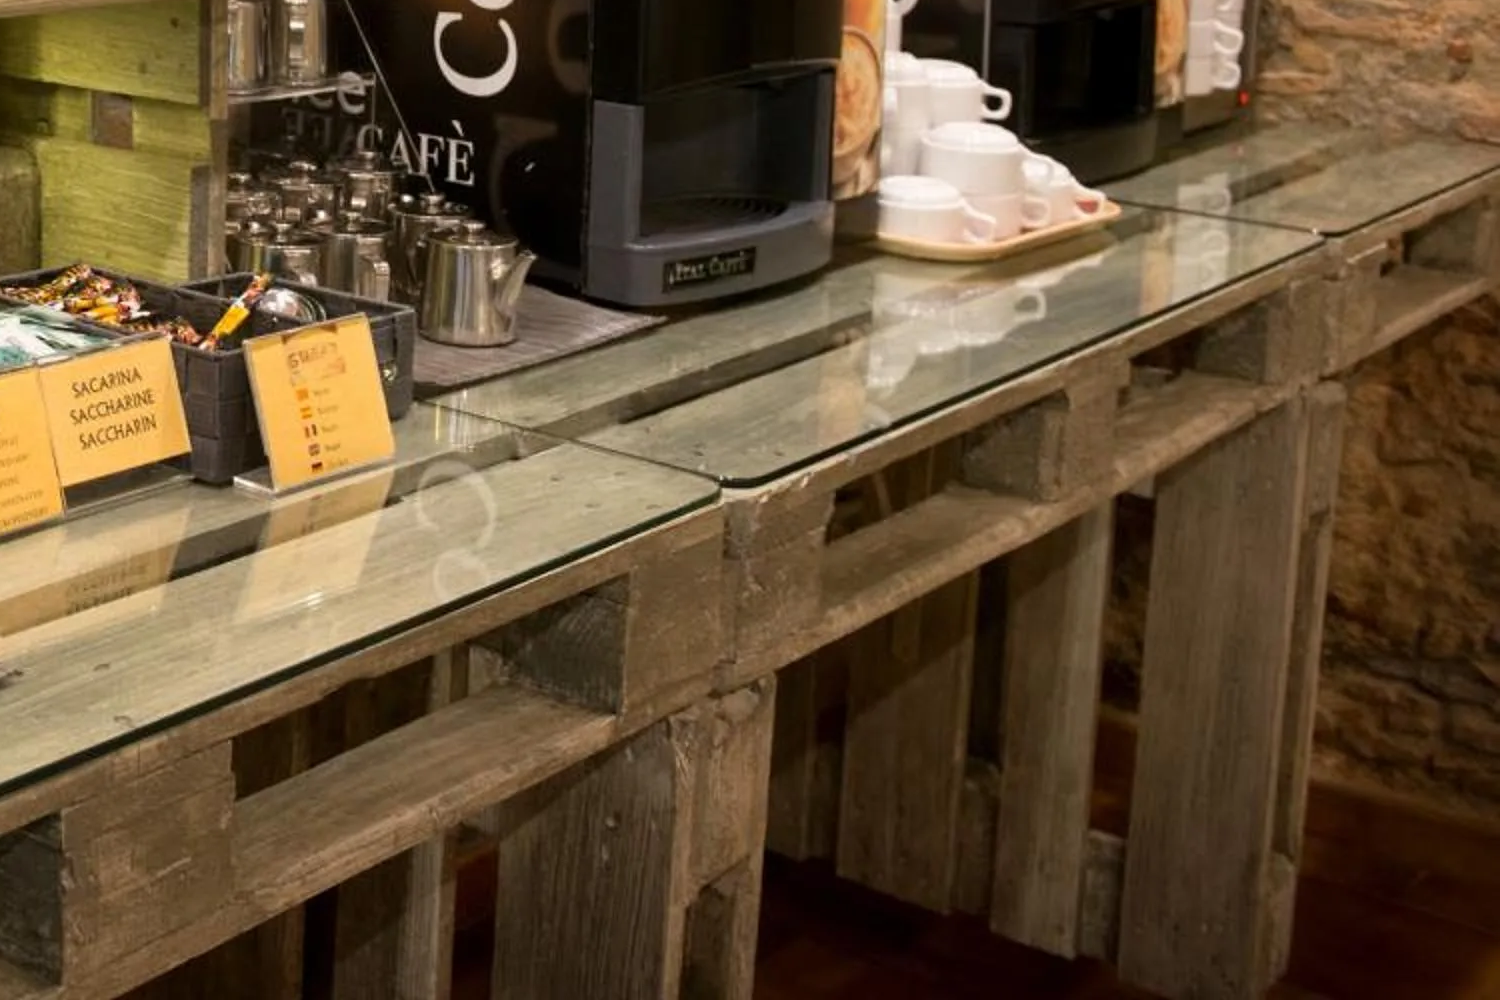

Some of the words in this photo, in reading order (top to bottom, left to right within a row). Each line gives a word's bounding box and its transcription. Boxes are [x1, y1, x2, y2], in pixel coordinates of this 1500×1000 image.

[71, 367, 143, 399] SACARINA
[69, 388, 157, 427] SACCHARINE
[78, 413, 158, 451] SACCHARIN
